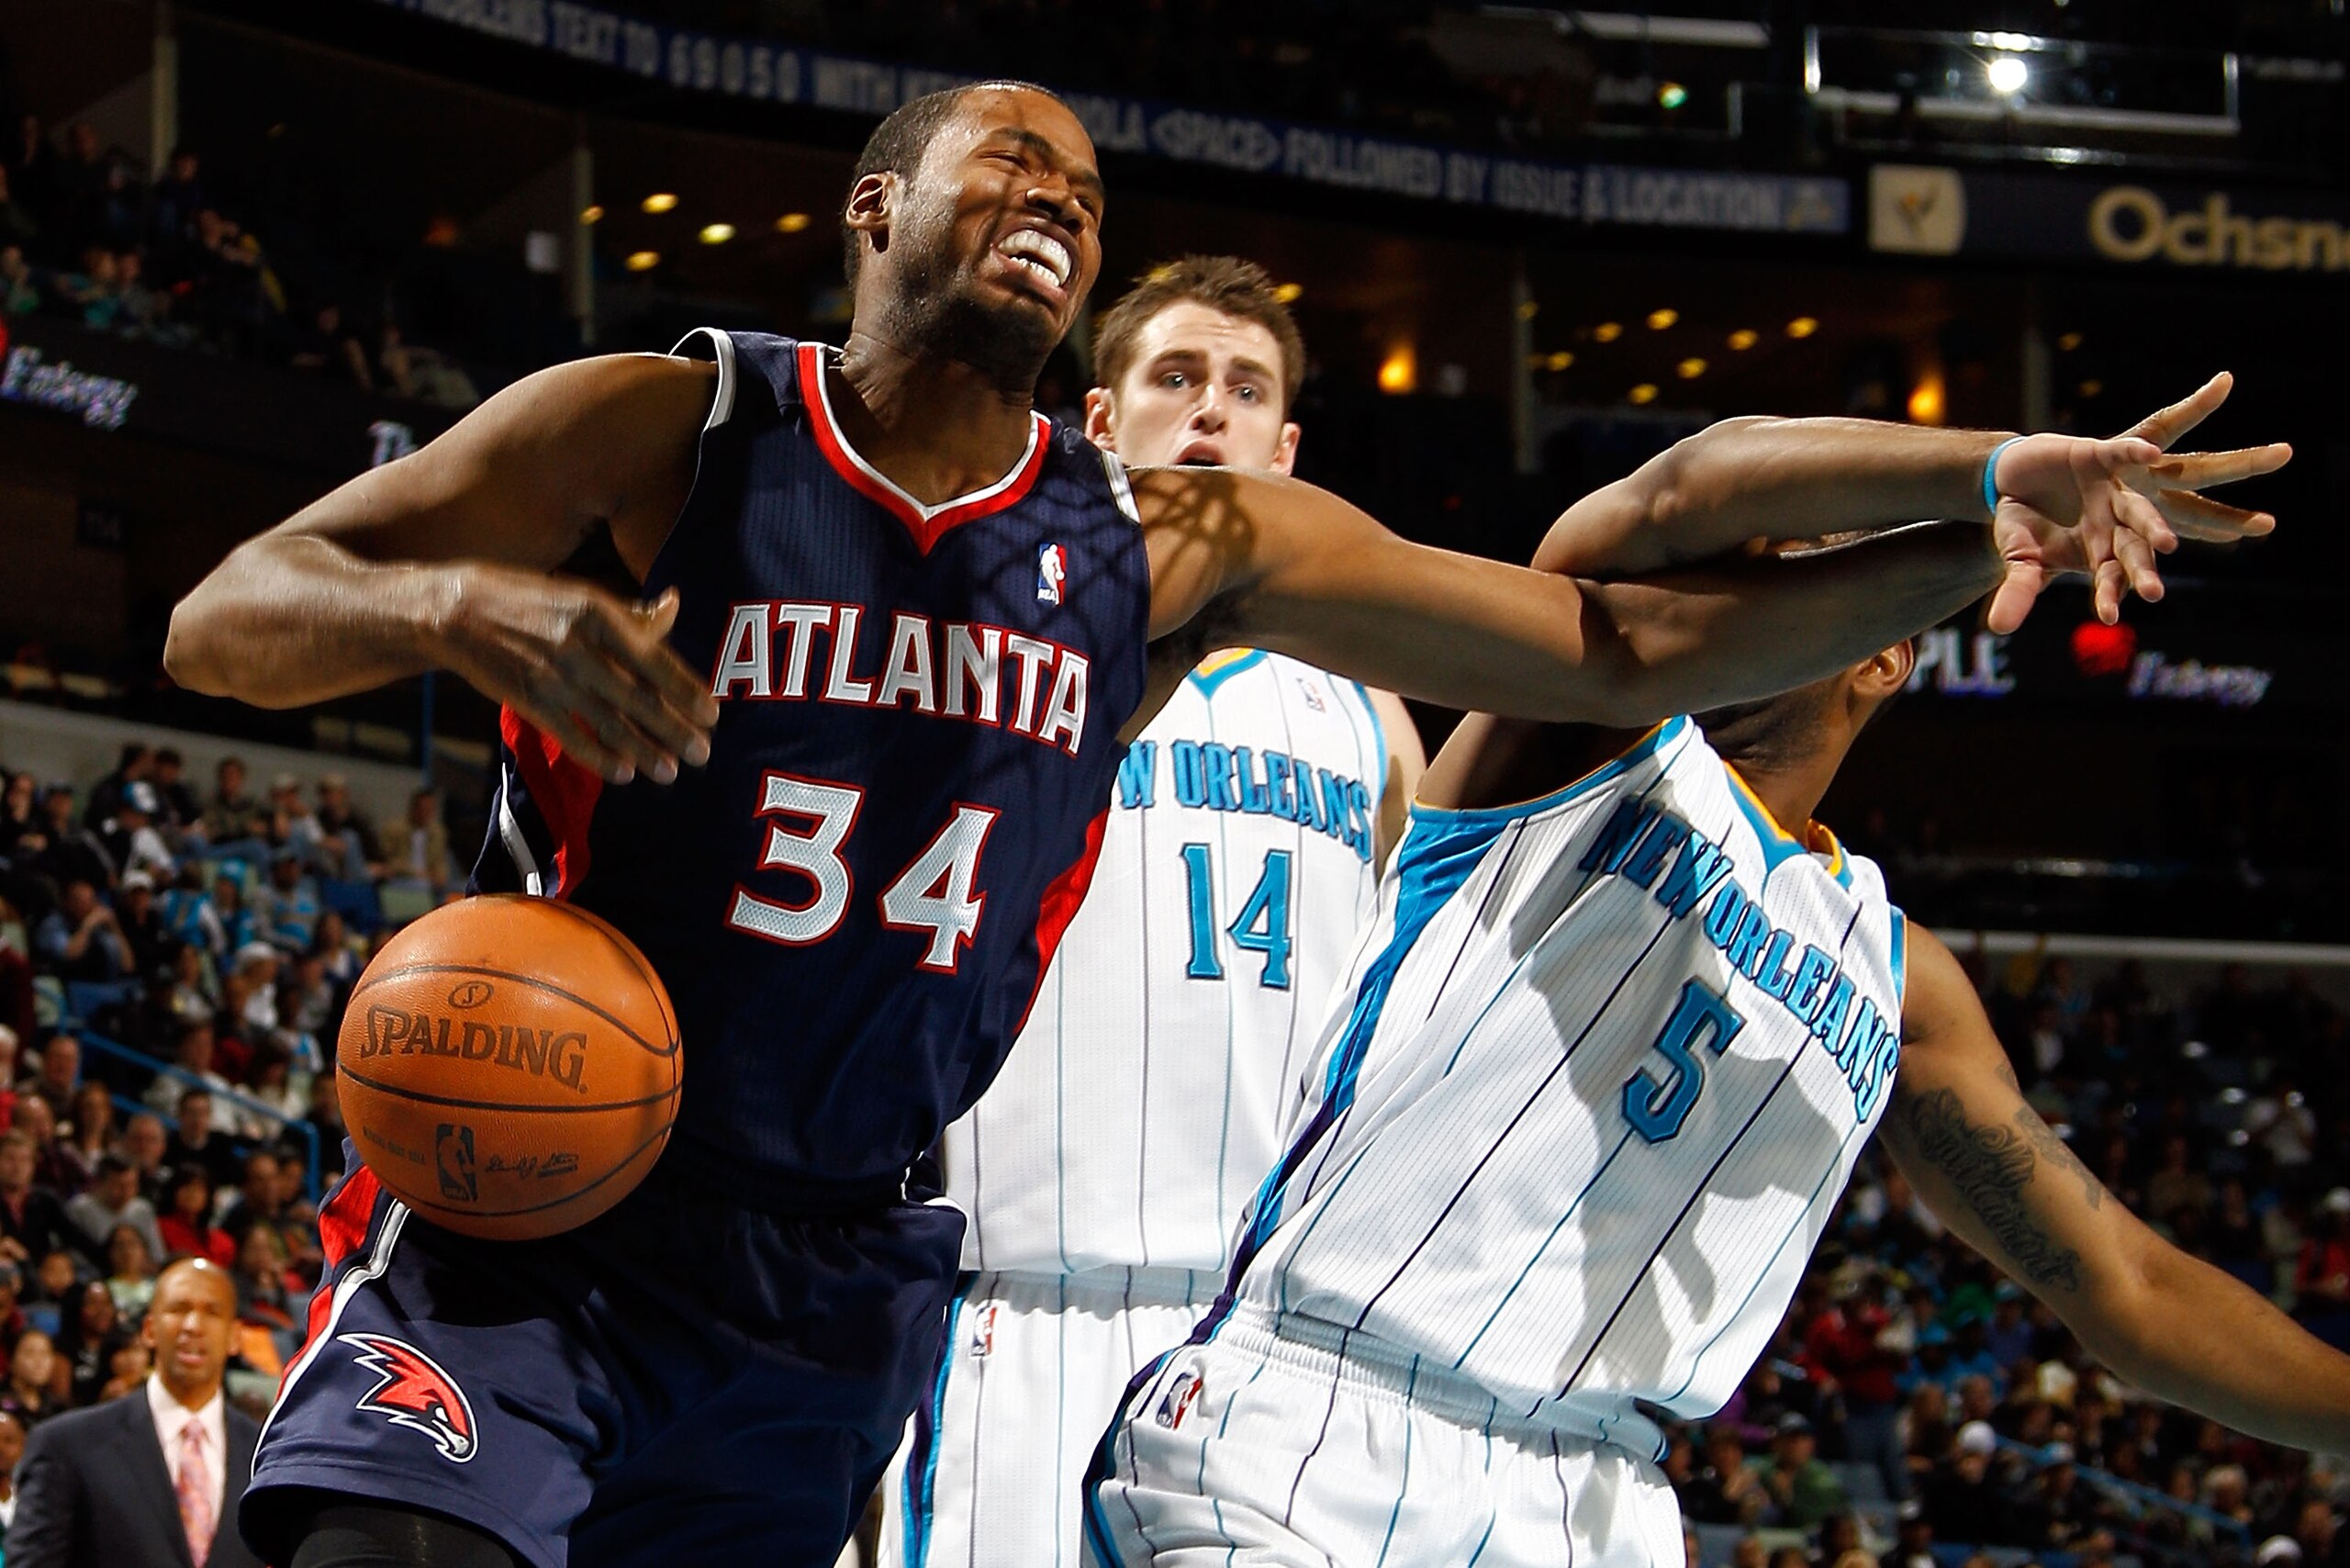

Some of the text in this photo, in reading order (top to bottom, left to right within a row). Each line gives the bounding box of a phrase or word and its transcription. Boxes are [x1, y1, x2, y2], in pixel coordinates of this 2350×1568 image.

[1285, 127, 1442, 198] FOLLOWED
[1613, 169, 1783, 230] LOCATION
[711, 599, 1091, 759] ATLANTA
[723, 768, 1002, 976] 34
[1171, 738, 1371, 864] ORLEANS
[1179, 842, 1294, 991] 14
[1578, 793, 1901, 1124] NEW ORLEANS
[361, 1004, 588, 1094] SPALDING
[1621, 975, 1747, 1145] 5
